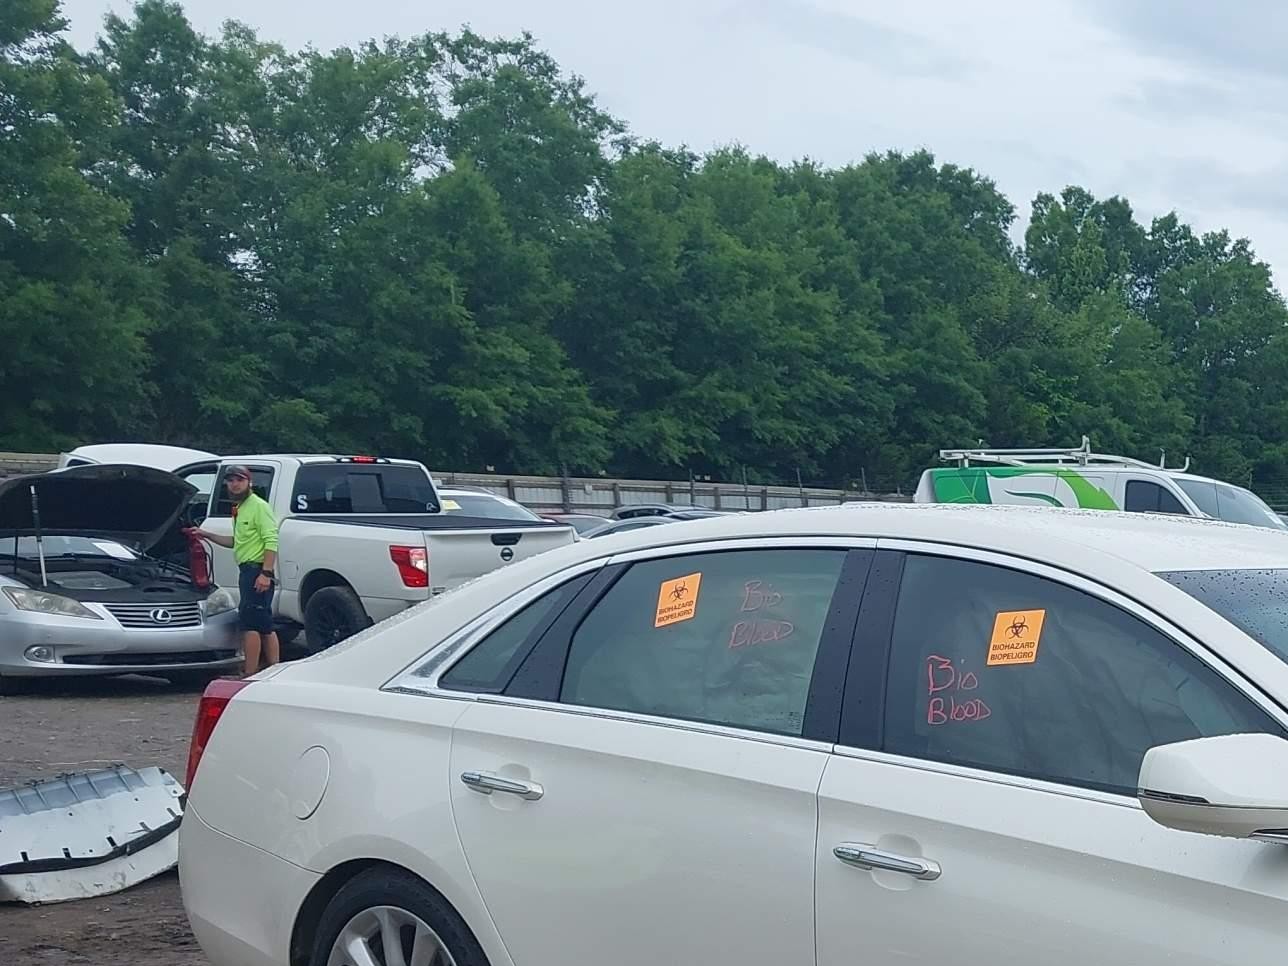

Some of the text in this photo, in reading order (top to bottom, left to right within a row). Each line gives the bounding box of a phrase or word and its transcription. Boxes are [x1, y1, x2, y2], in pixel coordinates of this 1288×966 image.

[297, 494, 308, 510] S
[658, 600, 694, 615] BIOHAZARD
[992, 641, 1035, 651] BIOHAZARD
[990, 651, 1034, 661] BIOPELIGRO
